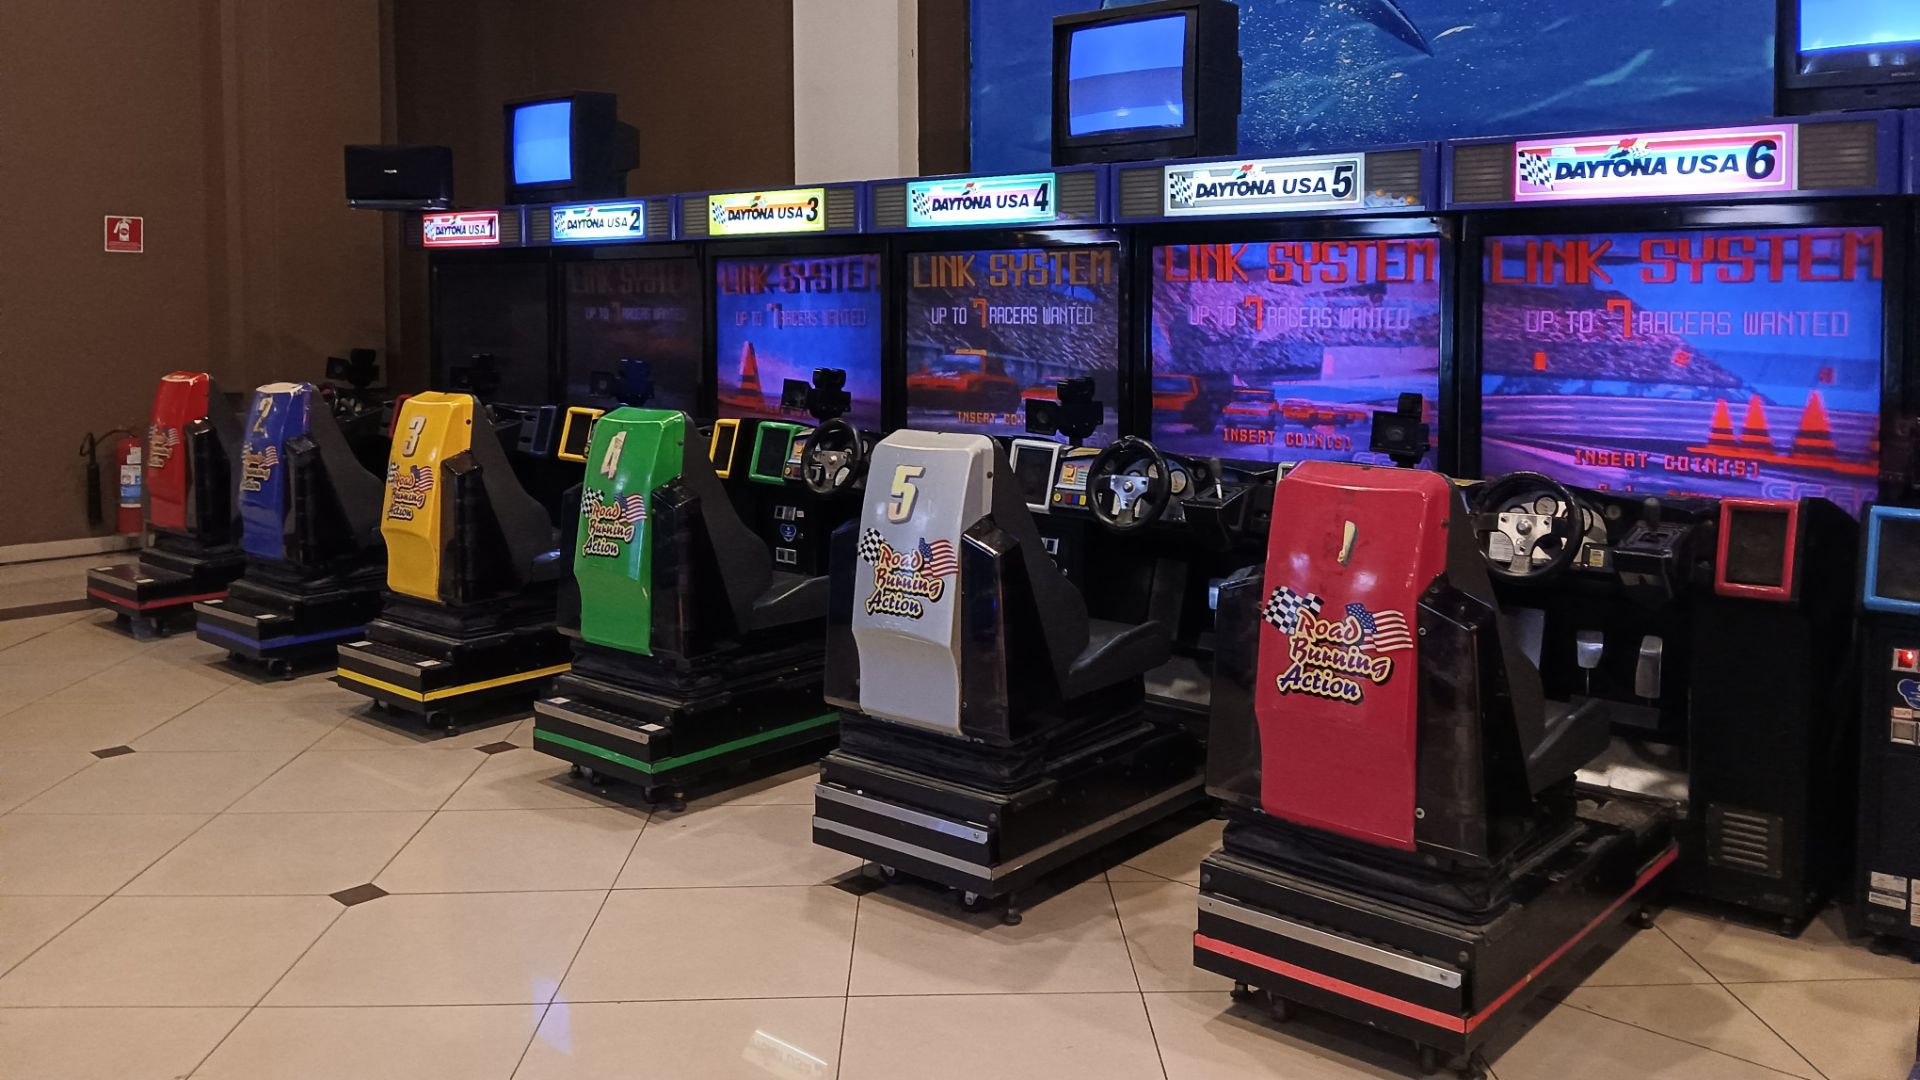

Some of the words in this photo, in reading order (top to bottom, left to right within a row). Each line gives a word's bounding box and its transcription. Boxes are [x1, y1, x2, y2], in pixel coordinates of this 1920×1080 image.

[1555, 156, 1667, 181] DAYTONA
[1677, 152, 1740, 175] USA
[1746, 139, 1777, 180] 6
[931, 194, 992, 212] DAYTONA
[996, 193, 1030, 209] USA
[1033, 182, 1049, 212] 4
[1195, 178, 1275, 199] DAYTONA
[1282, 177, 1327, 195] USA
[1331, 165, 1354, 199] 5
[435, 223, 467, 236] DAYTONA
[468, 223, 486, 235] USA
[487, 217, 495, 238] 1
[567, 217, 604, 229] DAYTONA
[607, 216, 628, 228] USA
[629, 208, 641, 232] 2
[727, 206, 775, 221] DAYTONA
[778, 204, 804, 220] USA
[806, 197, 819, 222] 3
[722, 262, 775, 295] LINK
[778, 254, 881, 295] SYSTEM
[912, 254, 976, 289] LINK
[989, 249, 1112, 288] SYSTEM
[1165, 243, 1248, 283] LINK
[1266, 239, 1436, 284] SYSTEM
[1491, 238, 1613, 284] LINK
[1639, 232, 1883, 284] SYSTEM
[931, 307, 948, 325] UP
[952, 307, 967, 325] TO
[972, 297, 988, 329] 7
[989, 306, 1038, 325] RACERS
[1042, 305, 1094, 325] WANTED
[1188, 306, 1209, 326] UP
[1216, 306, 1237, 326] TO
[1244, 295, 1264, 331] 7
[1266, 306, 1332, 328] RACERS
[1338, 306, 1410, 329] WANTED
[1525, 310, 1553, 333] UP
[1566, 310, 1595, 334] TO
[1606, 299, 1633, 338] 7
[1639, 310, 1732, 336] RACERS
[1743, 311, 1850, 337] WANTED
[253, 395, 273, 435] 2
[957, 411, 996, 425] INSERT
[403, 414, 427, 458] 3
[1222, 427, 1275, 445] INSERT
[1285, 432, 1352, 452] COIN(S)
[600, 430, 628, 481] 4
[1574, 449, 1648, 469] INSERT
[591, 499, 622, 520] Road
[887, 464, 927, 525] 5
[583, 534, 620, 557] Action
[588, 519, 635, 544] Burning
[879, 543, 923, 572] Road
[874, 566, 944, 602] Burning
[866, 588, 924, 618] Action
[1295, 607, 1364, 646] Road
[1289, 634, 1393, 685] Burning
[1276, 661, 1363, 704] Action
